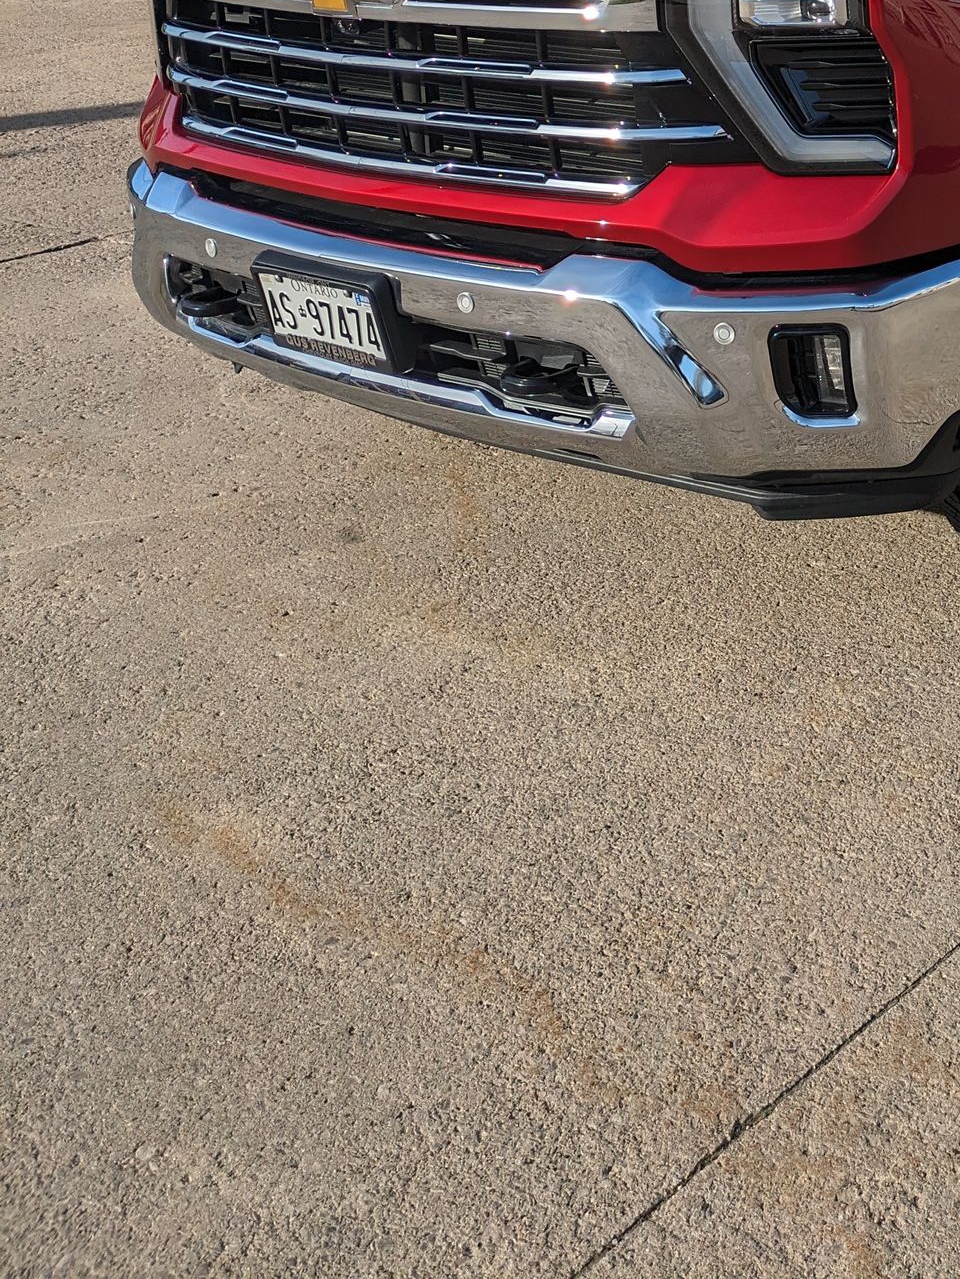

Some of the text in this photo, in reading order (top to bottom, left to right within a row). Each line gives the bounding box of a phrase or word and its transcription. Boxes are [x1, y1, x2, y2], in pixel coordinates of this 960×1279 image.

[291, 278, 338, 299] ONTARIO
[285, 333, 309, 349] GUS
[310, 338, 377, 367] REVENBERG
